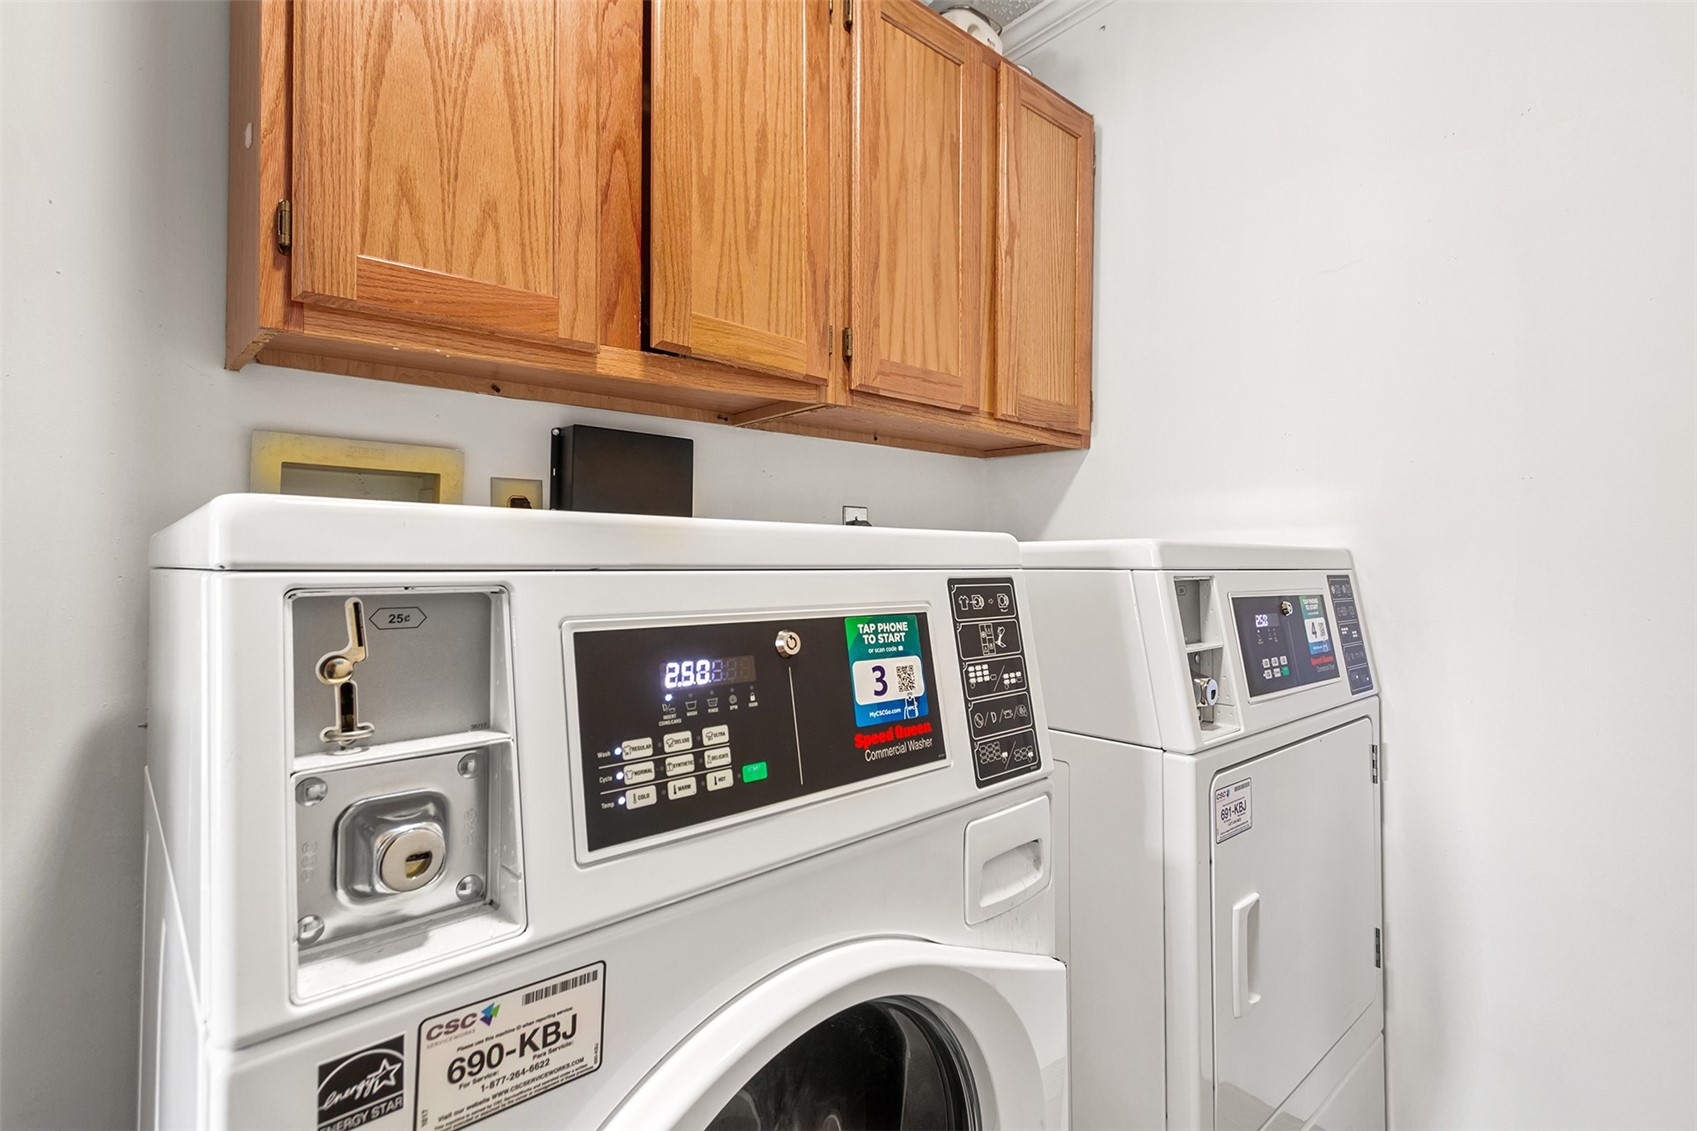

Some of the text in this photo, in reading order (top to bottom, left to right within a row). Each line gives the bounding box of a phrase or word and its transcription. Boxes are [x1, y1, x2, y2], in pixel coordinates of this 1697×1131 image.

[388, 613, 411, 624] 25¢
[857, 622, 908, 634] TAP PHONE
[1311, 621, 1318, 639] 4
[863, 632, 906, 645] TO START
[871, 665, 888, 697] 3
[869, 707, 902, 718] MyCSCGo.com
[674, 737, 690, 745] DELUXE
[713, 731, 726, 739] ULTRA
[854, 722, 933, 750] Speed Queen
[631, 743, 652, 753] REGULAR
[864, 738, 933, 762] Commercial Washer
[597, 750, 611, 759] Wash
[711, 753, 729, 762] DELICATE
[672, 760, 694, 769] SYNTHETIC
[634, 768, 653, 777] NORMAL
[598, 775, 613, 784] Cycle
[678, 784, 692, 792] WARM
[637, 793, 650, 801] COLD
[601, 800, 615, 810] Temp
[1221, 800, 1247, 821] 691-KBJ
[426, 1011, 478, 1041] CSC
[447, 1013, 578, 1085] 690-KBJ
[532, 1040, 574, 1061] Para Servicio:
[459, 1070, 500, 1090] For Service:
[480, 1058, 550, 1093] 1-877-264-6622
[491, 1057, 585, 1100] WWW.CSCSERVICEWORKS.COM
[319, 1076, 381, 1111] energy
[371, 1096, 404, 1119] STAR
